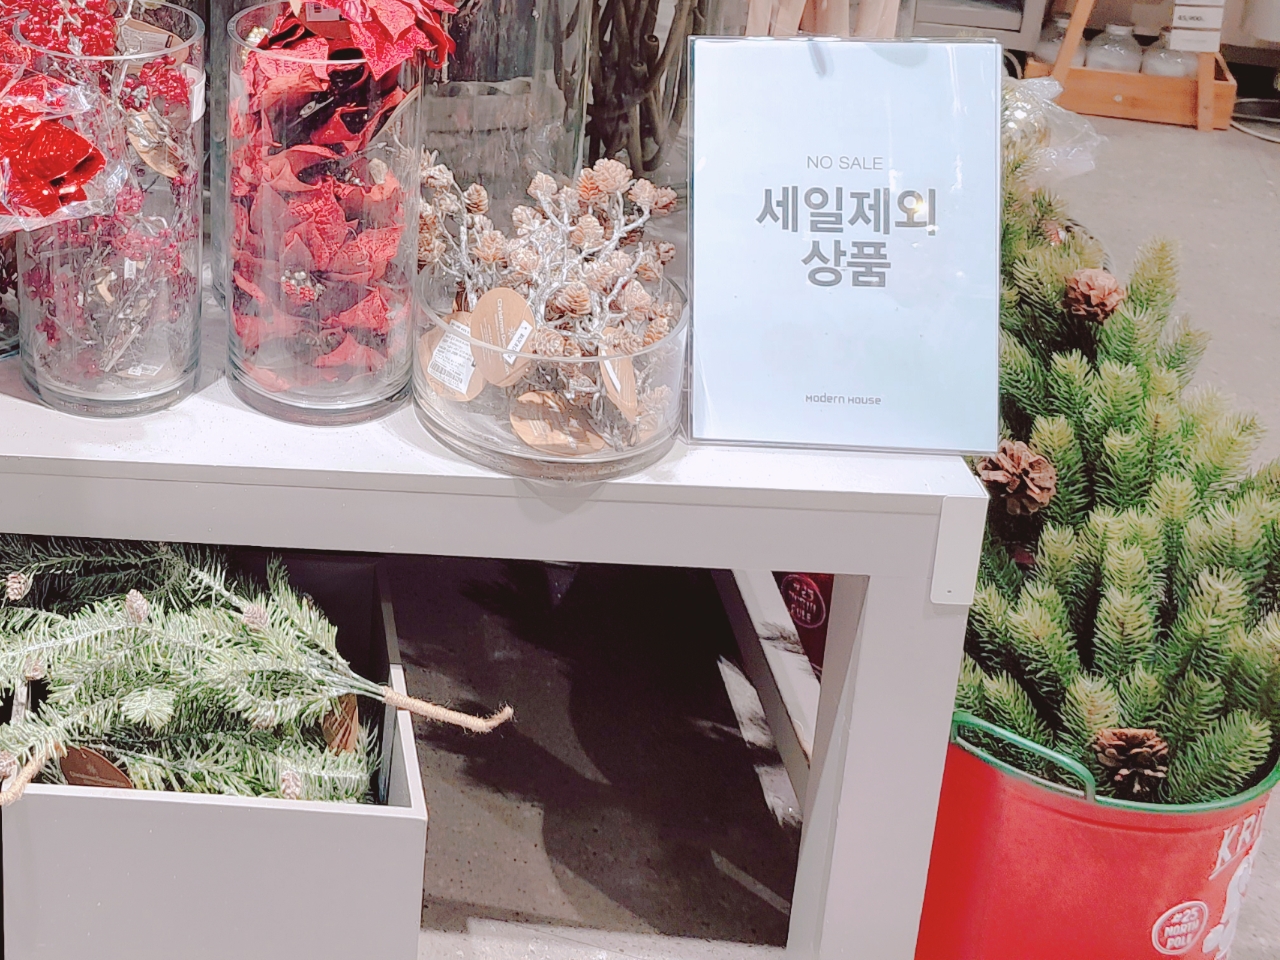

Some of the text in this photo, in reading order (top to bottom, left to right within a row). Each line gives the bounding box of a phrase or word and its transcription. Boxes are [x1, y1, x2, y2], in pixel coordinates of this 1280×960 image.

[806, 155, 883, 171] NO SALE
[755, 185, 936, 236] 세일제외
[801, 239, 892, 288] 상품
[805, 392, 845, 404] Modern
[1164, 919, 1200, 938] NORTH
